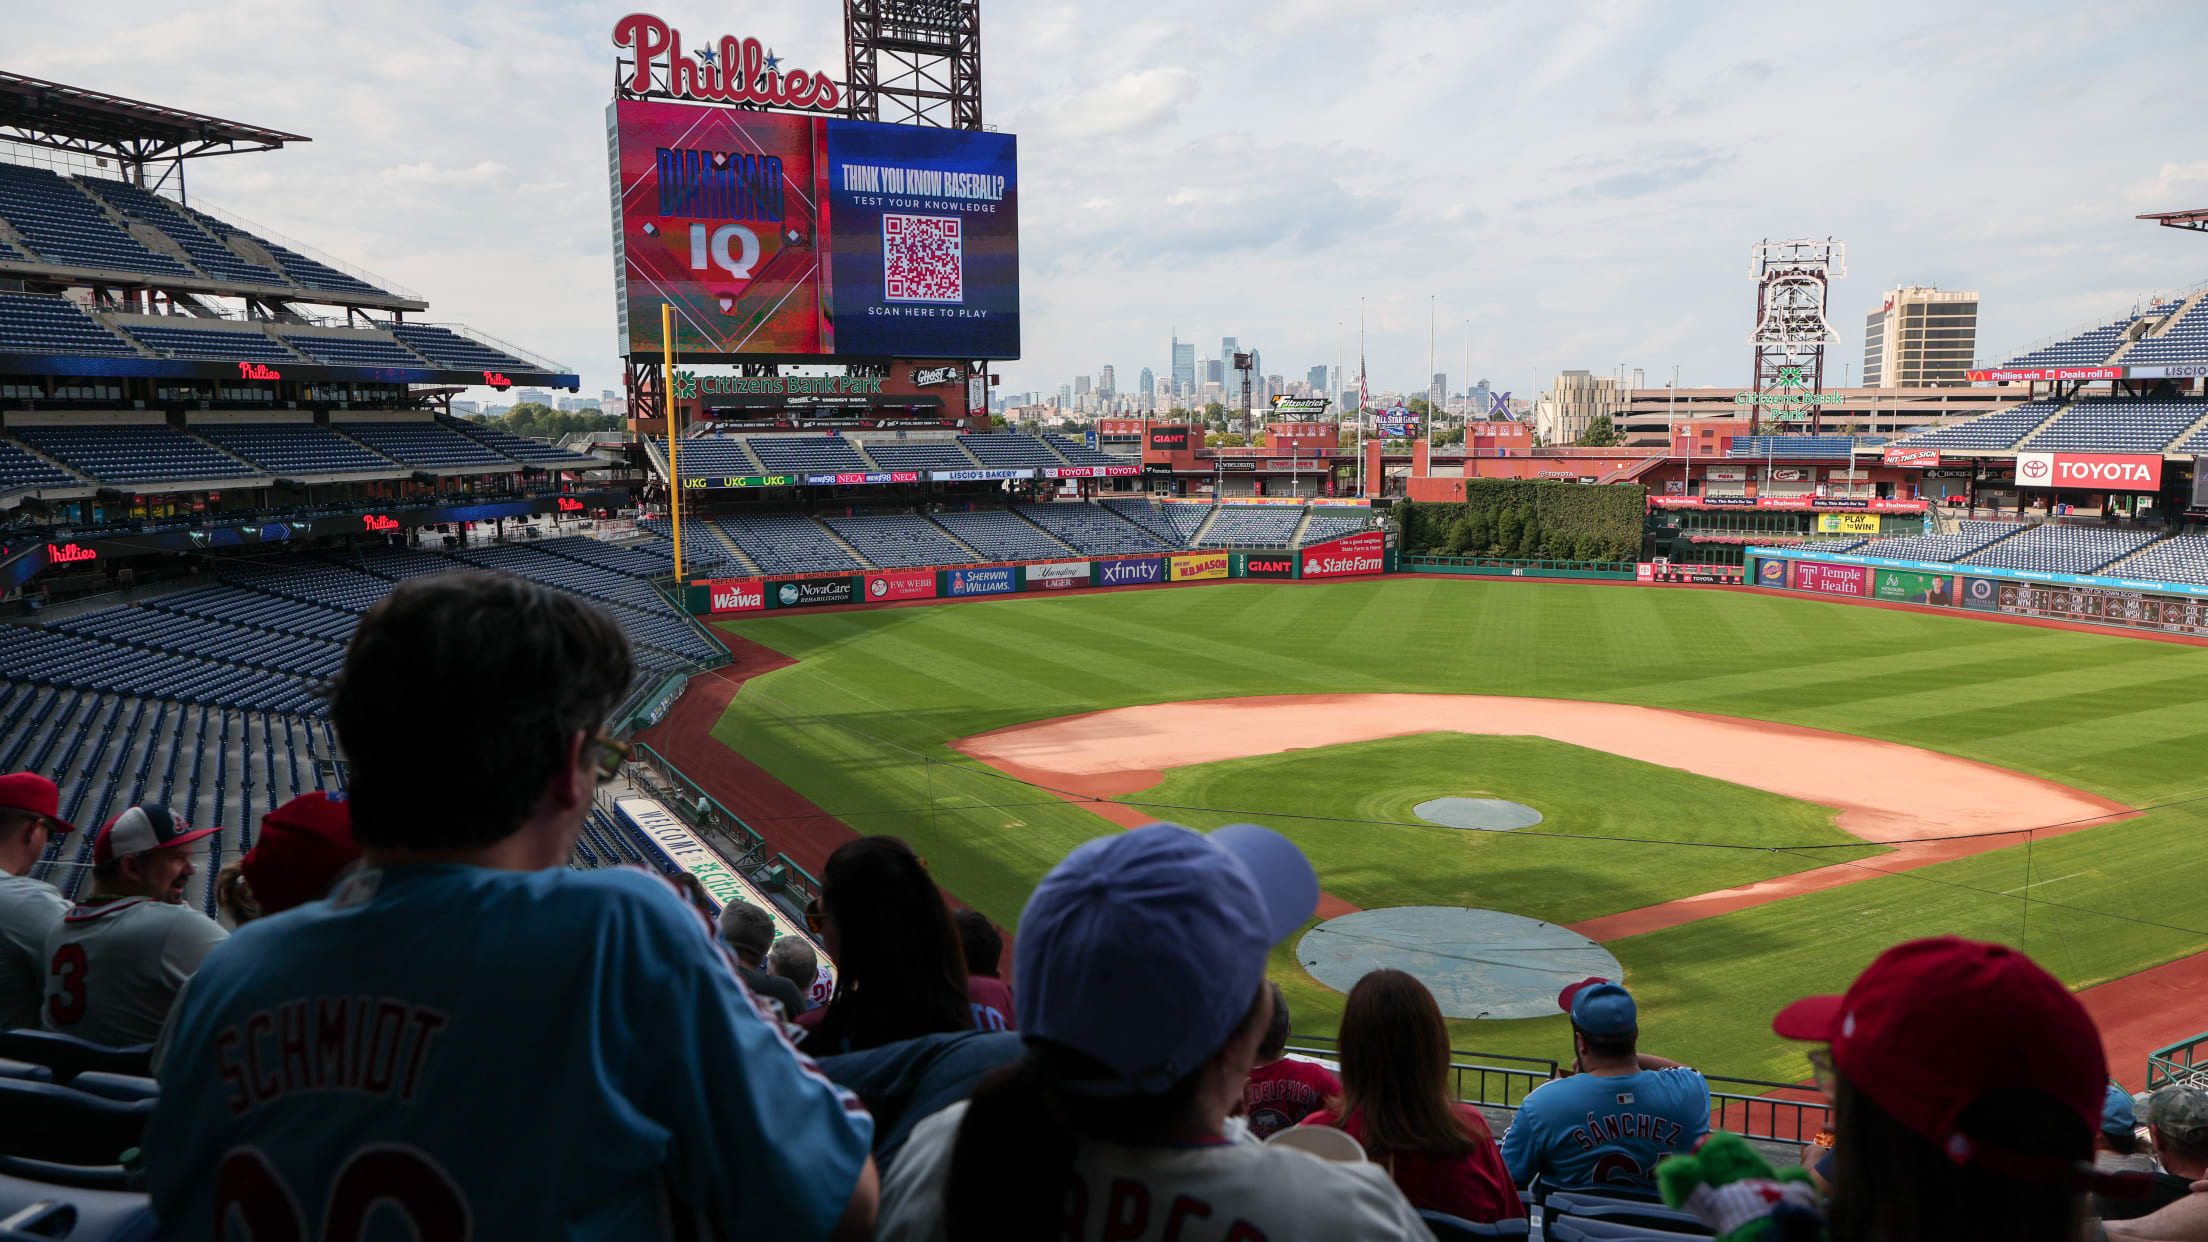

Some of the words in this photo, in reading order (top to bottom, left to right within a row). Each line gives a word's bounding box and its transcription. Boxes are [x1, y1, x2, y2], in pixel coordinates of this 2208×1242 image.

[612, 13, 840, 111] Phillies
[656, 147, 784, 222] DIAMOND
[842, 164, 879, 193] THINK
[881, 167, 905, 194] YOU
[906, 169, 942, 197] KNOW
[944, 171, 1005, 200] BASEBALL?
[853, 196, 883, 206] TEST
[889, 198, 920, 208] YOUR
[925, 200, 996, 213] KNOWLEDGE
[689, 223, 760, 279] IQ
[868, 307, 900, 316] SCAN
[905, 308, 935, 317] HERE
[940, 309, 954, 317] TO
[959, 310, 987, 318] PLAY
[239, 362, 280, 380] Phillies
[917, 367, 949, 386] GHOST
[1992, 372, 2022, 380] Phillies
[2060, 370, 2085, 379] Deals
[2087, 370, 2102, 378] roll
[2103, 370, 2114, 378] in
[483, 371, 511, 386] Phillies
[701, 375, 784, 394] Citizens
[787, 375, 837, 394] Bank
[840, 375, 882, 394] Park
[1275, 395, 1324, 408] Fitzpatrick
[1736, 391, 1799, 405] Citizens
[1802, 391, 1843, 405] Bank
[1403, 416, 1420, 424] GAME
[1770, 408, 1806, 421] Park
[1153, 434, 1184, 443] GIANT
[1900, 453, 1917, 462] THIS
[1918, 450, 1937, 458] SIGN
[893, 472, 918, 481] NECA
[985, 470, 1017, 478] BAKERY
[1108, 467, 1138, 475] TOYOTA
[2058, 462, 2151, 481] TOYOTA
[683, 478, 707, 488] UKG
[723, 477, 747, 487] UKG
[762, 476, 785, 485] UKG
[838, 474, 864, 483] NECA
[558, 498, 584, 511] Phillies
[363, 514, 399, 531] Phillies
[1845, 515, 1866, 523] PLAY
[1038, 565, 1079, 577] Yuengling
[1104, 561, 1158, 582] xfinity
[1248, 561, 1292, 572] GIANT
[1511, 568, 1524, 577] 401
[966, 571, 1008, 582] SHERWIN
[1821, 566, 1860, 581] Temple
[800, 582, 850, 596] NovaCare
[907, 579, 932, 588] WEBB
[1045, 578, 1072, 588] LAGER
[1821, 580, 1857, 593] Health
[800, 594, 849, 603] REHABILITATION
[2018, 590, 2031, 599] HOU
[2072, 594, 2083, 603] CIN
[713, 593, 761, 609] Wawa
[2017, 599, 2031, 607] NYM
[2126, 601, 2140, 609] MIA
[2070, 604, 2083, 613] CHC
[2125, 610, 2140, 619] WSH
[2185, 606, 2199, 615] COL
[2185, 616, 2198, 625] ATL
[637, 810, 703, 856] WELCOME
[701, 871, 750, 905] Citize
[50, 943, 87, 1025] 3
[216, 993, 451, 1120] SCHMIDT
[1249, 1079, 1311, 1105] DELPHIA
[1573, 1111, 1684, 1152] SÁNCHEZ
